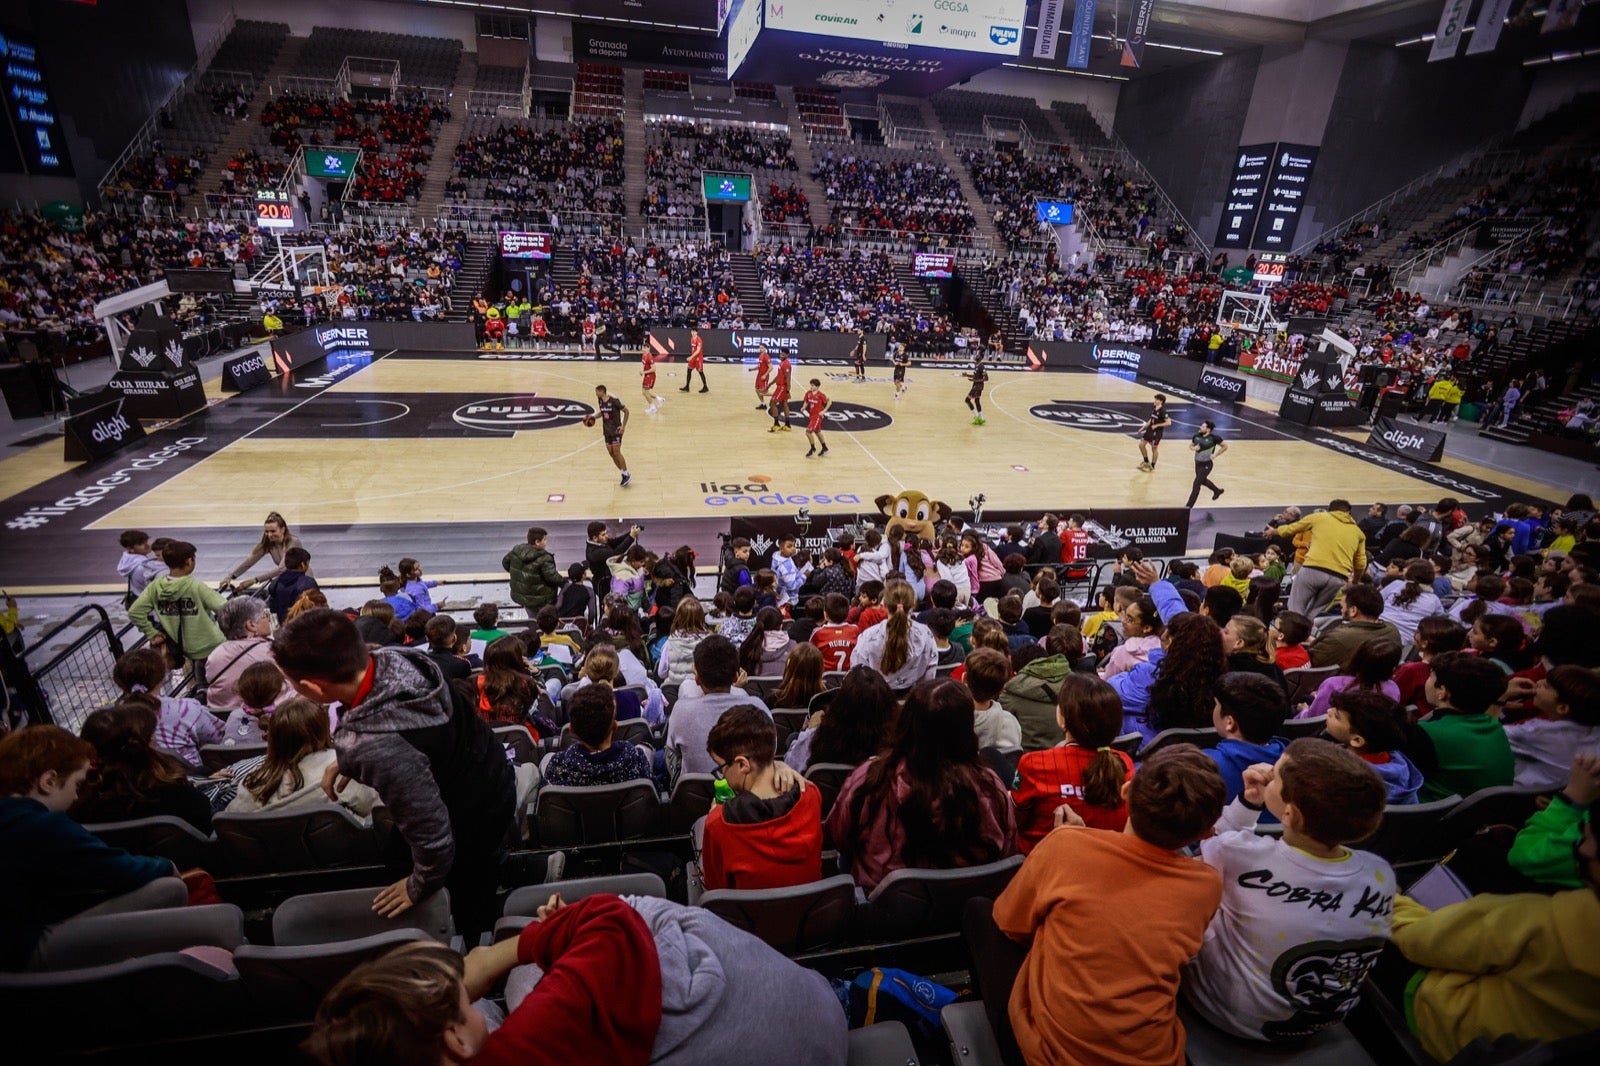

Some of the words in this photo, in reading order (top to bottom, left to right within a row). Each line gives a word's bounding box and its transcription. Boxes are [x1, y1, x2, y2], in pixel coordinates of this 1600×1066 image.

[1040, 3, 1056, 55] INMACULADA
[589, 38, 628, 50] Granada
[598, 48, 627, 58] deporte
[662, 45, 725, 61] AYUNTAMIENTO
[259, 204, 278, 218] 20
[1258, 264, 1269, 274] 20
[1270, 265, 1284, 275] 20
[257, 289, 294, 298] endesa
[322, 328, 368, 342] BERNER
[743, 337, 799, 348] BERNER
[1101, 350, 1141, 362] BERNER
[232, 356, 265, 377] endesa
[135, 381, 169, 389] RURAL
[1203, 374, 1242, 393] endesa
[467, 404, 586, 414] PULEVA
[1033, 408, 1133, 421] PULEVA
[92, 414, 131, 443] alight
[1383, 429, 1424, 450] alight
[5, 436, 208, 530] #ligaendesa
[701, 482, 769, 495] liga
[704, 492, 861, 506] endesa
[1125, 528, 1146, 537] CAJA
[1148, 527, 1178, 536] RURAL
[1135, 536, 1166, 544] GRANADA
[1073, 545, 1086, 559] 19
[834, 650, 847, 673] 7
[1237, 869, 1344, 913] COBRA
